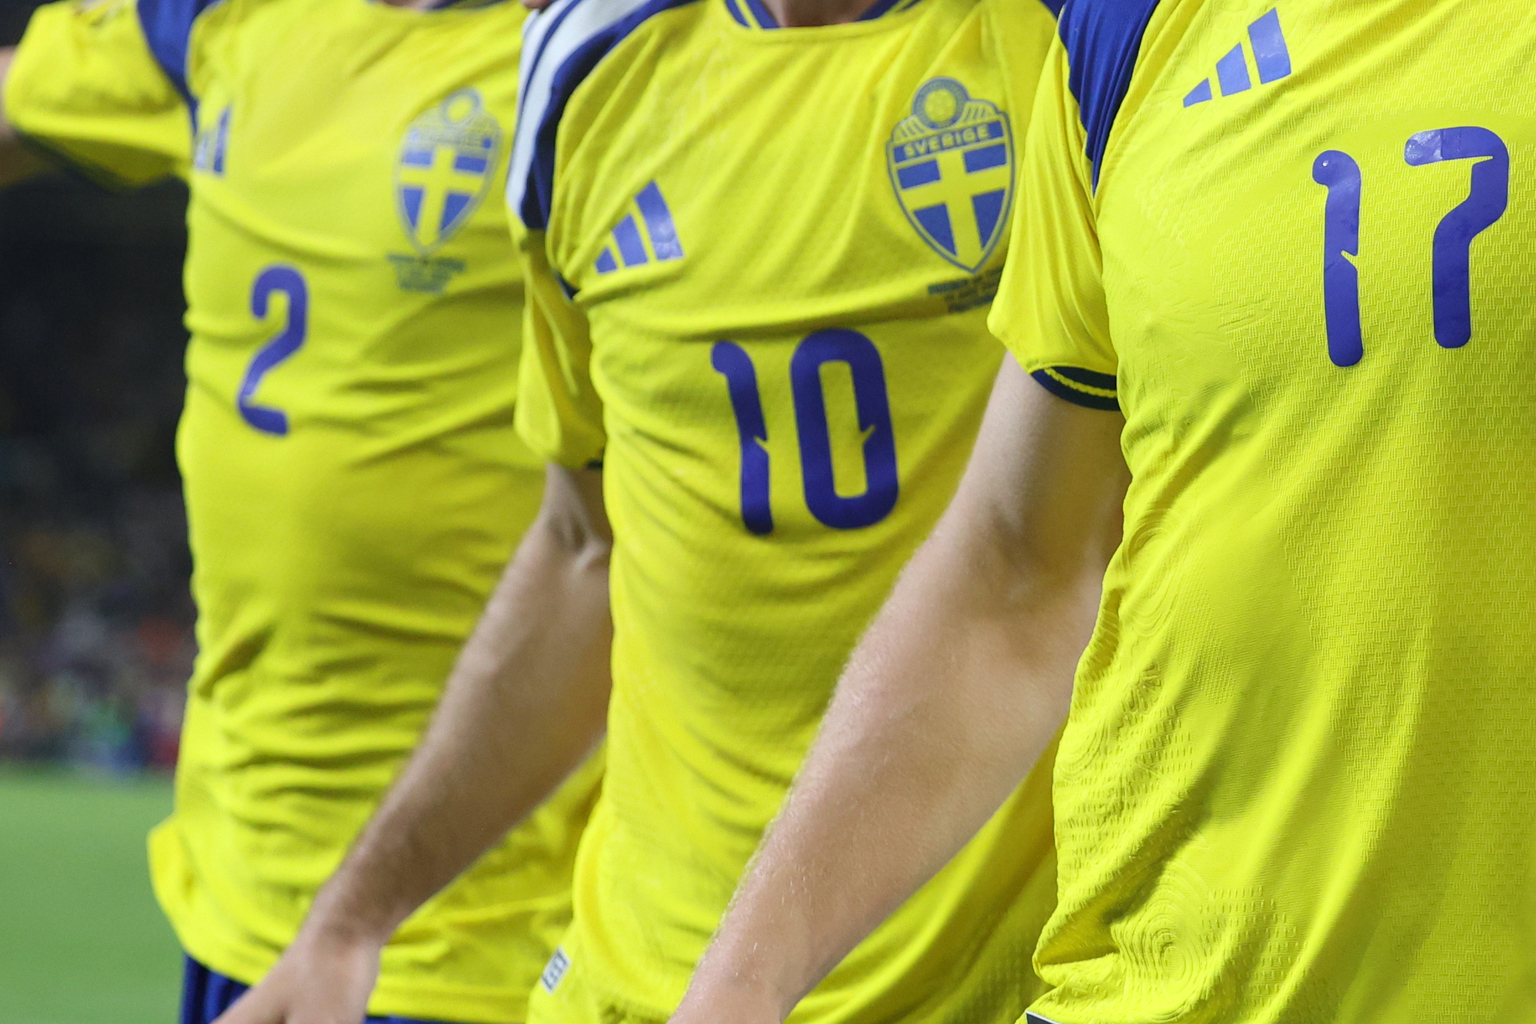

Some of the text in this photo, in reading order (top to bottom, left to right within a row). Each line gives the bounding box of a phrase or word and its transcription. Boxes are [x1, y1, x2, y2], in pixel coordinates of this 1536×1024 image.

[905, 126, 989, 159] SVERIGE
[1312, 126, 1510, 367] 17
[237, 263, 308, 436] 2
[711, 328, 898, 535] 10
